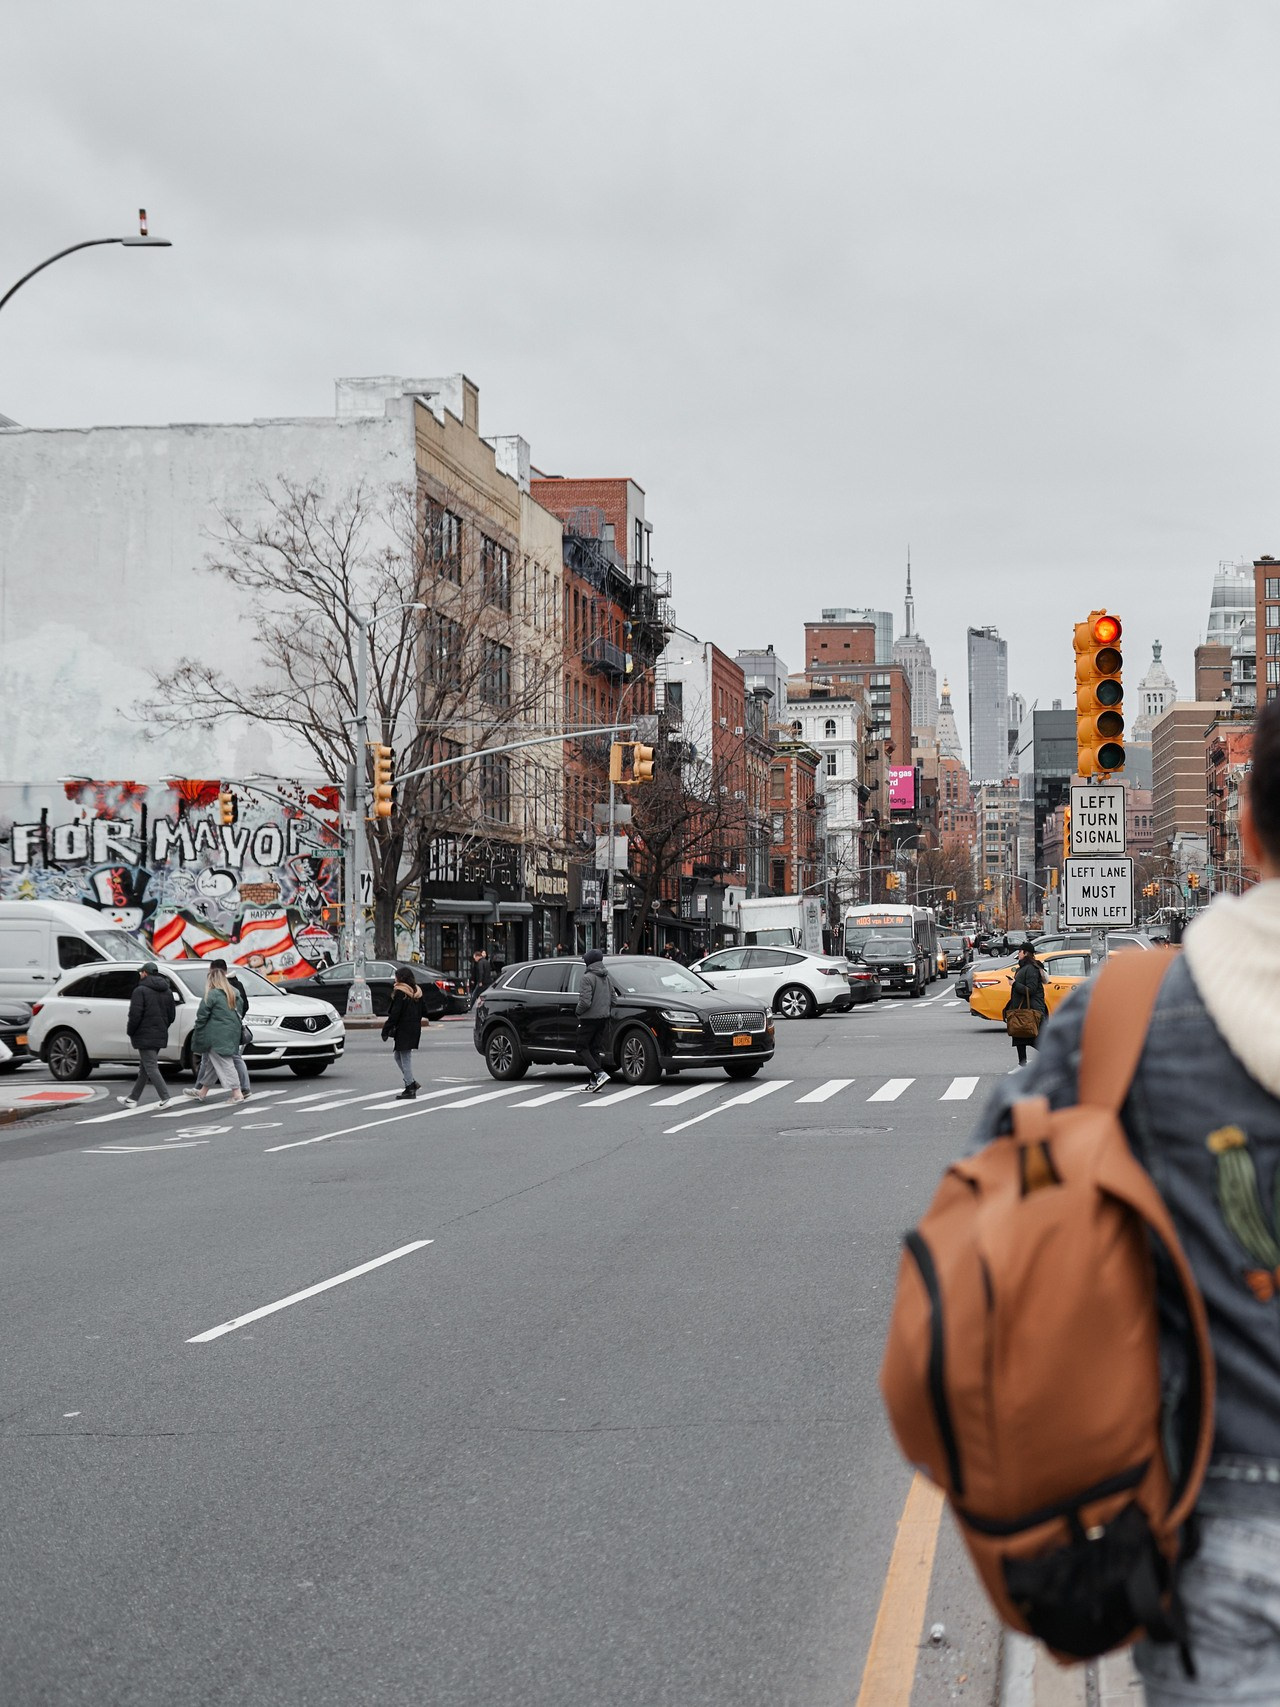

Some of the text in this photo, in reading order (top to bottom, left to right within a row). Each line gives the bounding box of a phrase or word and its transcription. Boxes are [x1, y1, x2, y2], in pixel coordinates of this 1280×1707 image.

[899, 771, 912, 779] gas
[1080, 796, 1115, 808] LEFT
[1079, 813, 1118, 826] TURN
[11, 817, 140, 865] FOR
[152, 814, 325, 870] MAYOR
[1075, 830, 1121, 843] SIGNAL
[1071, 867, 1127, 878] LEFT LANE
[1082, 885, 1116, 898] MUST
[250, 910, 277, 919] HAPPY
[1071, 906, 1127, 917] TURN LEFT
[856, 917, 871, 925] M103
[896, 916, 904, 924] AV
